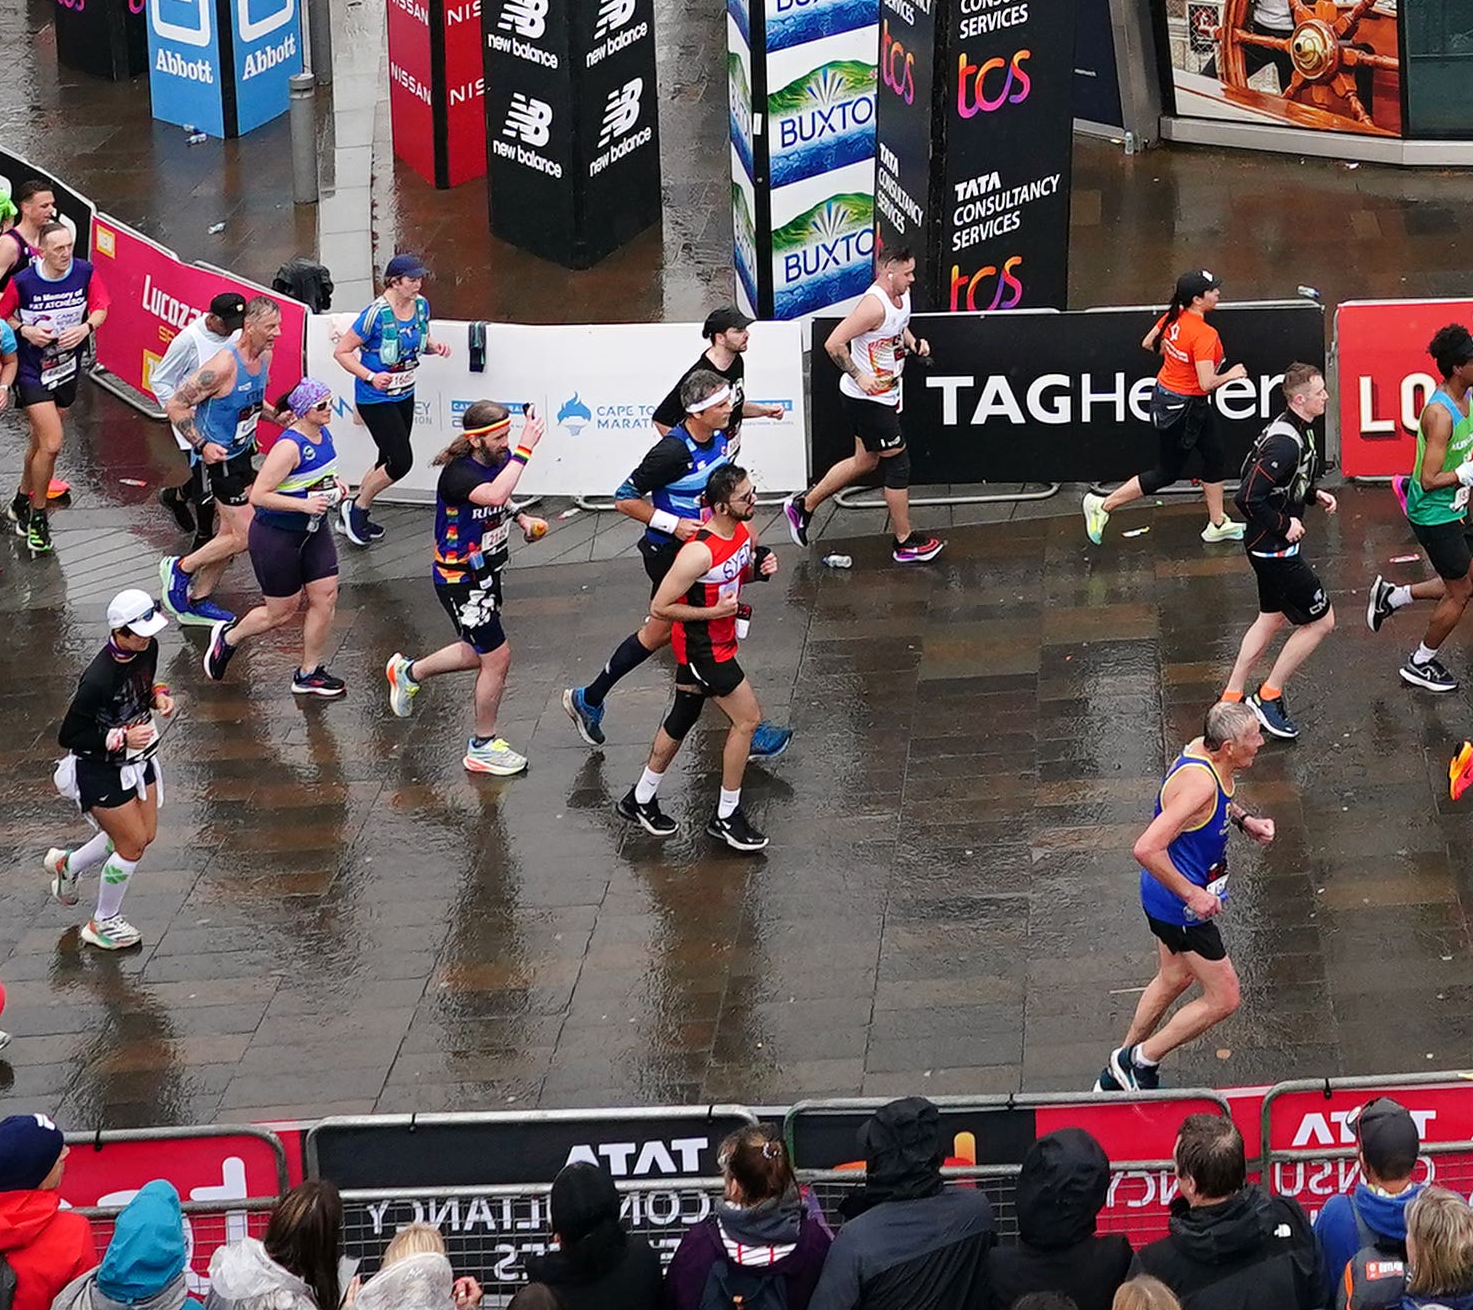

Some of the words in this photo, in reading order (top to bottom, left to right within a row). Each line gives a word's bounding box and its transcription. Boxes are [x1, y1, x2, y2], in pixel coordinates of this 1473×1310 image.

[960, 4, 1028, 38] SERVICES
[243, 34, 295, 80] Abbott
[488, 34, 511, 52] new
[513, 38, 558, 68] balance
[587, 44, 606, 67] new
[610, 21, 649, 56] balance
[882, 18, 916, 106] tcs
[156, 49, 213, 83] Abbott
[391, 62, 431, 105] NISSAN
[957, 48, 1031, 119] tcs
[493, 140, 516, 159] new
[518, 145, 561, 178] balance
[590, 152, 609, 176] new
[611, 127, 651, 162] balance
[954, 172, 1060, 225] CONSULTANCY
[955, 172, 1001, 201] TATA
[953, 211, 1020, 251] SERVICES
[596, 405, 623, 417] CAPE
[926, 371, 1281, 426] TAGHeer
[597, 418, 655, 430] MARAT
